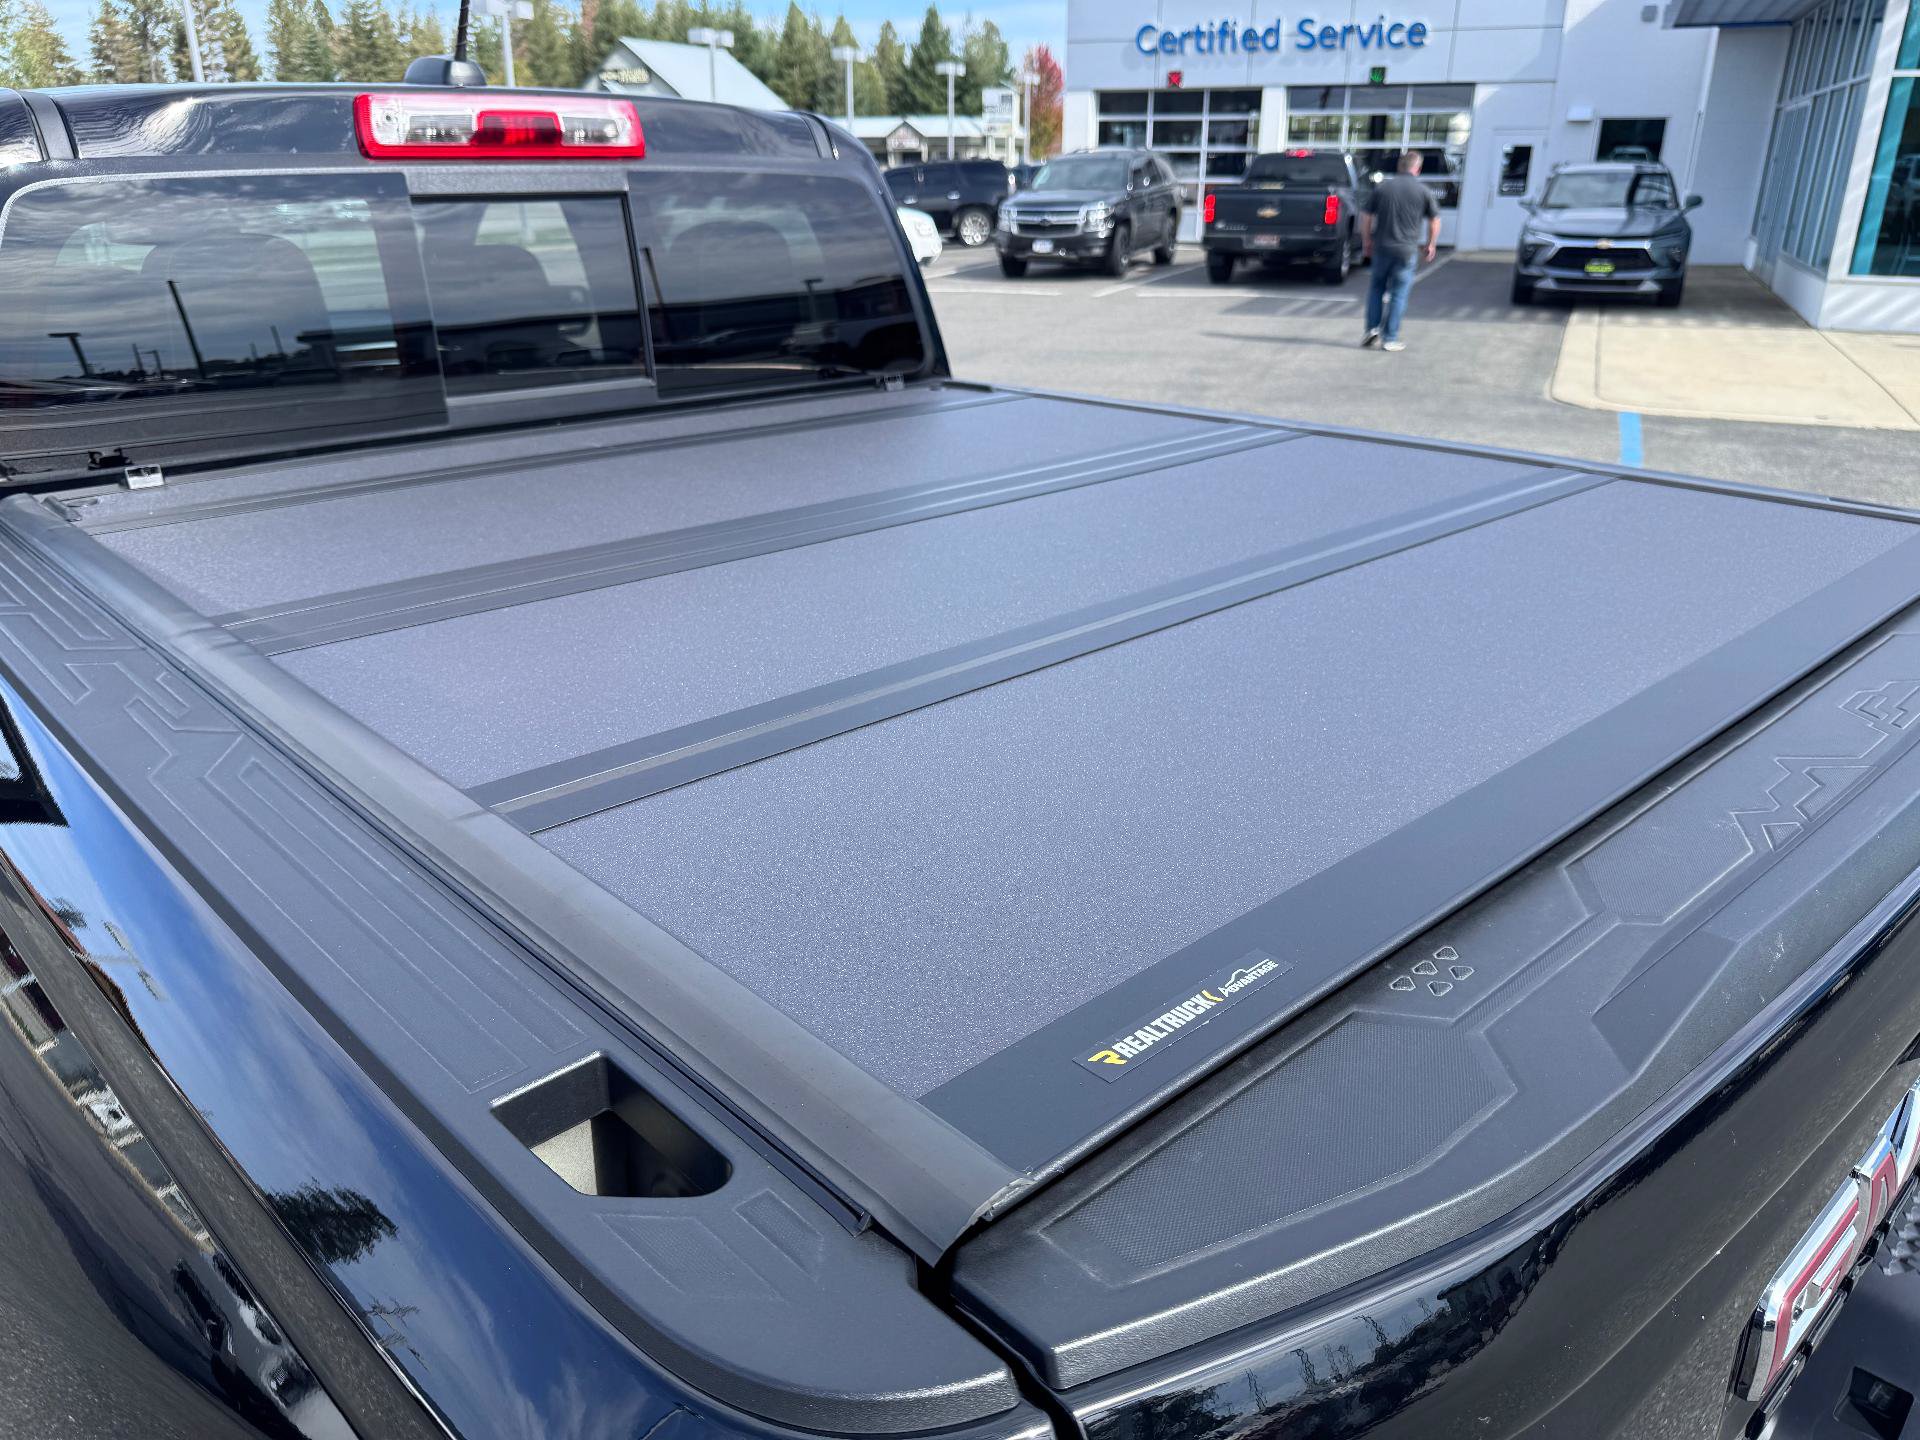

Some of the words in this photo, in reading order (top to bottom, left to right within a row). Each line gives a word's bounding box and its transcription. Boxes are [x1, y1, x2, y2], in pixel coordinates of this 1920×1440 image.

[1136, 18, 1281, 55] Certified
[1296, 15, 1427, 50] Service
[1112, 990, 1217, 1059] REALTRUCK
[1218, 960, 1279, 998] ADVANTAGE
